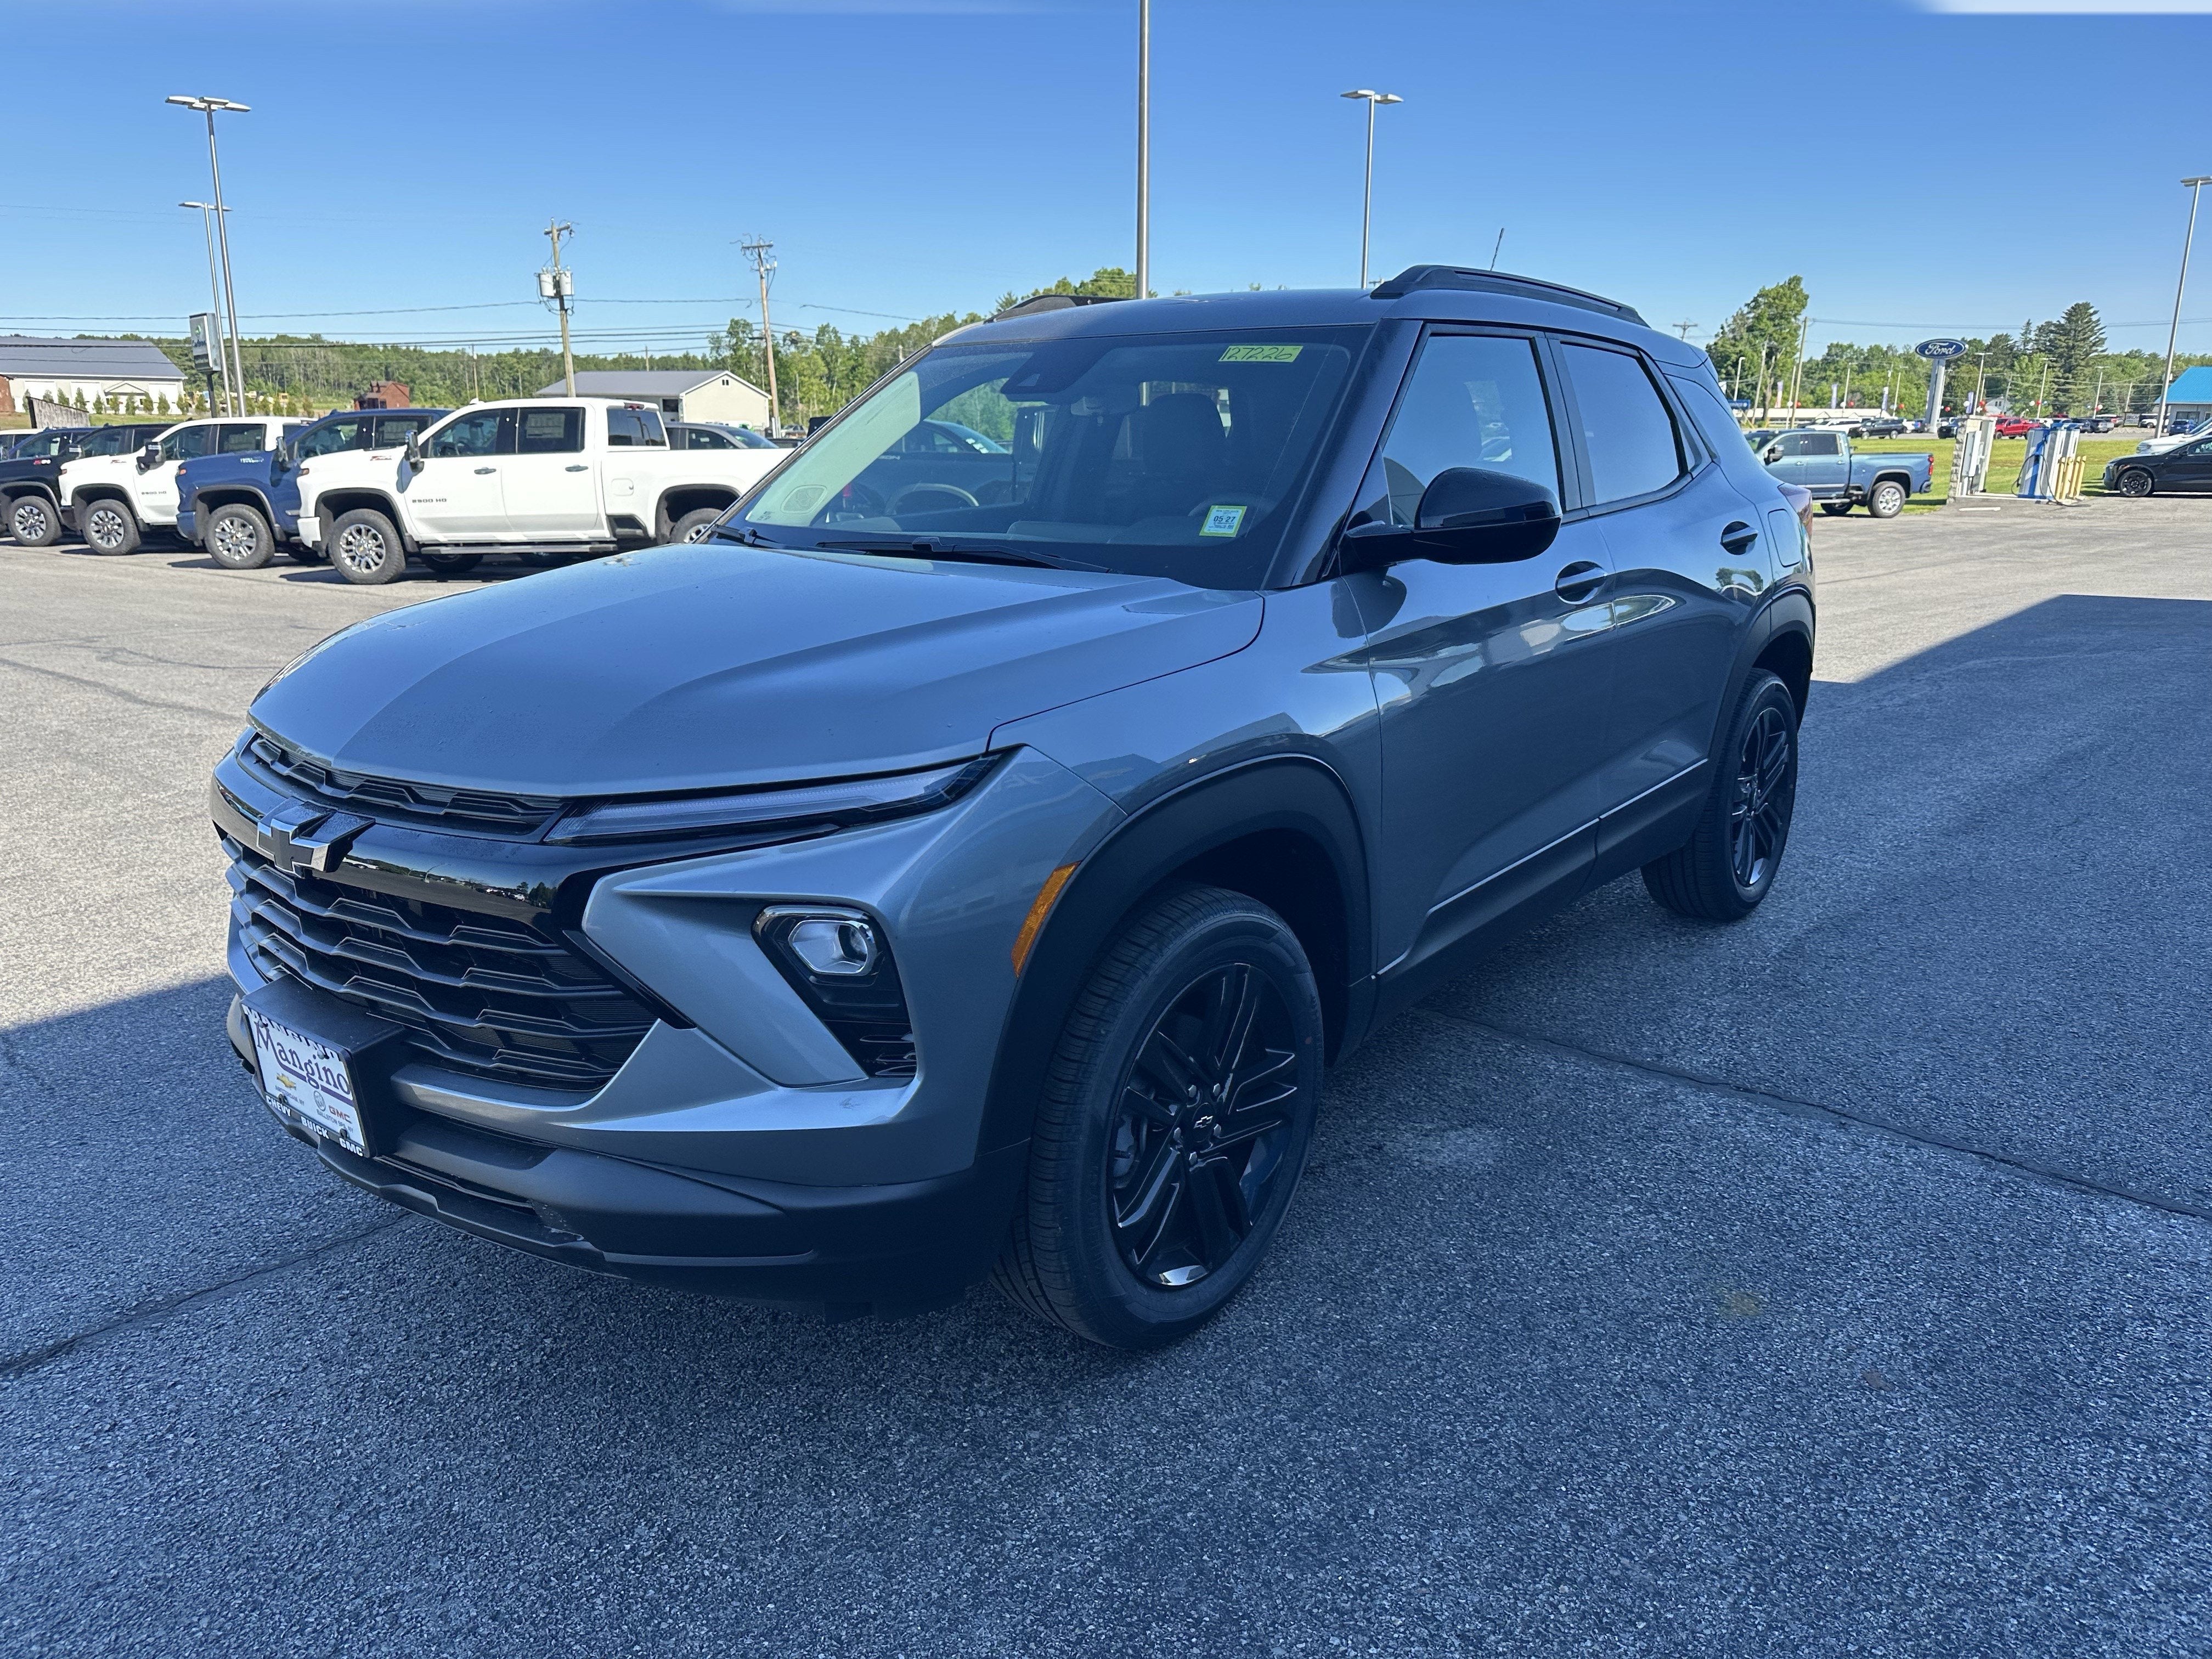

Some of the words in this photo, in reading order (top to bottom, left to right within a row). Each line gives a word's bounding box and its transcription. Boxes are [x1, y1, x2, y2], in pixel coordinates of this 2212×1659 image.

[1925, 342, 1956, 355] Ford
[254, 1020, 352, 1096] Mangino
[266, 1095, 292, 1117] CHEVY
[329, 1105, 352, 1124] GMC
[301, 1116, 330, 1139] BUICK
[339, 1137, 363, 1156] GMC
